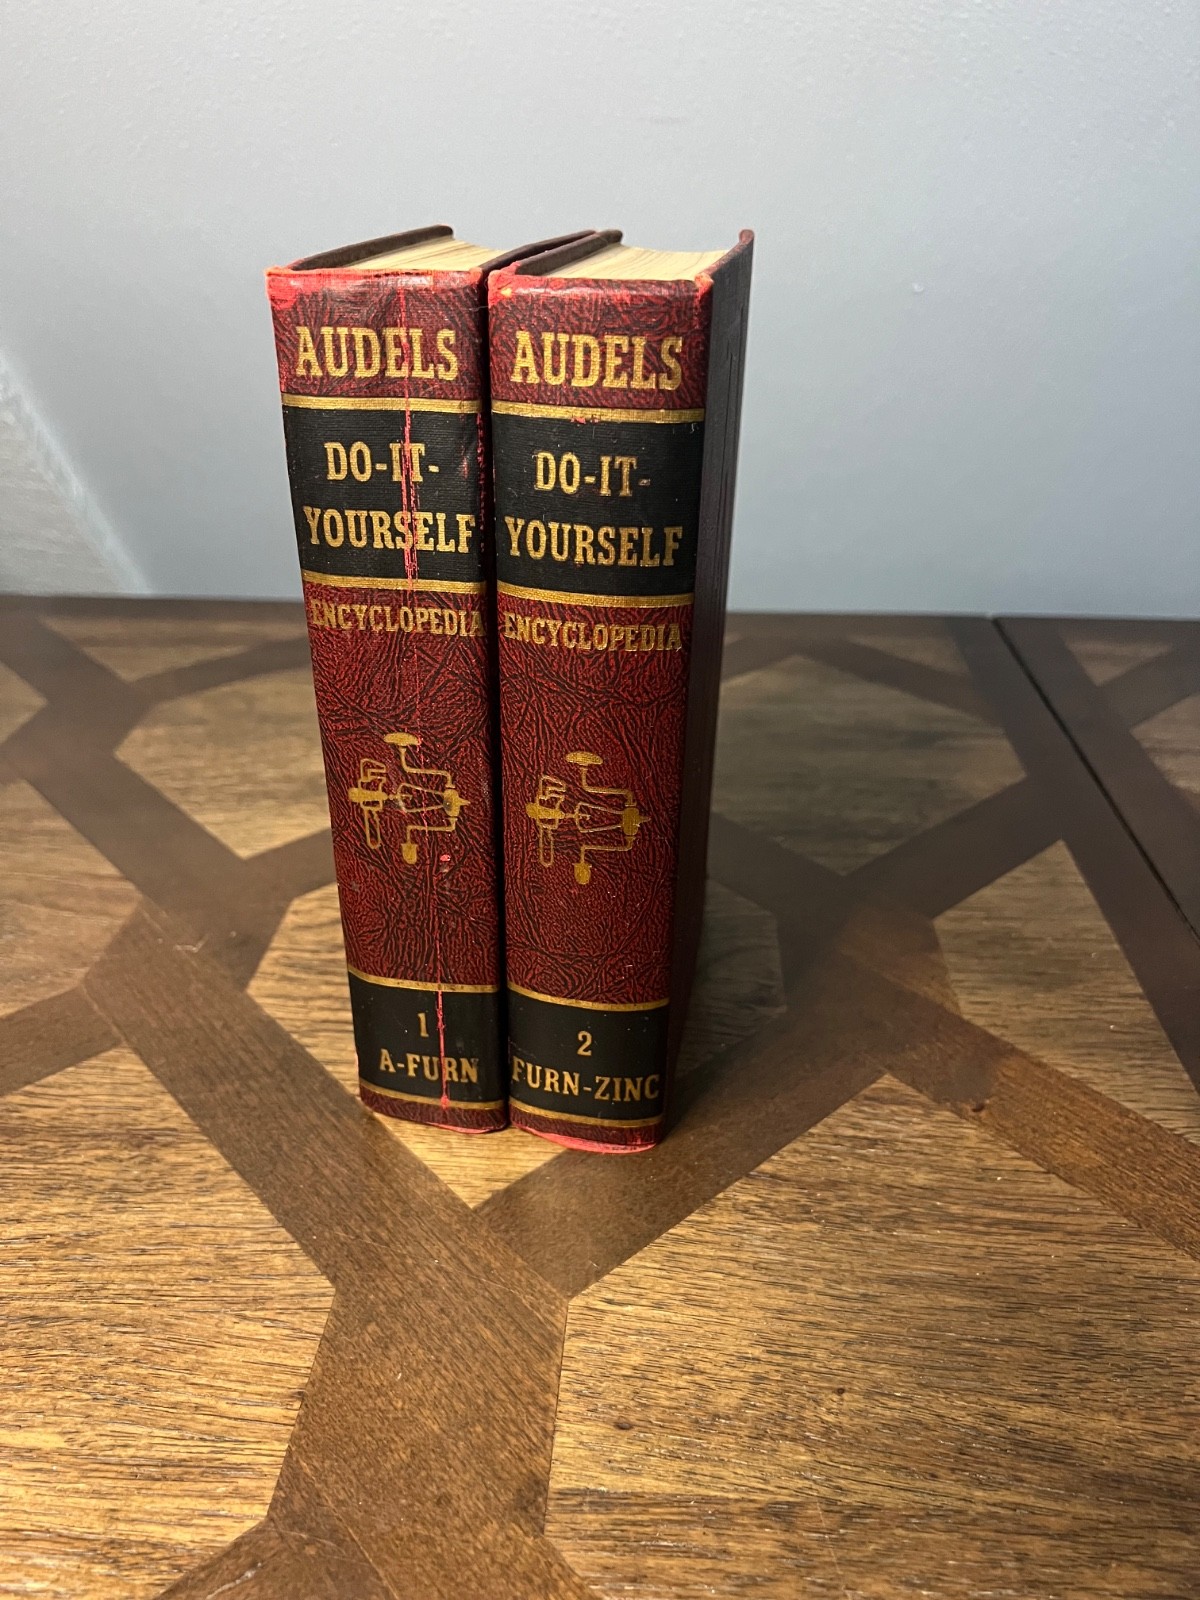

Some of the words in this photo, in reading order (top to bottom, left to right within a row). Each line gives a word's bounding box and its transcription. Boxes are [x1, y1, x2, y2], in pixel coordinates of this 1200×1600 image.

[296, 326, 458, 382] AUDELS
[511, 331, 683, 391] AUDELS
[324, 441, 439, 482] DO-IT-
[533, 451, 651, 497] DO-IT-
[304, 504, 476, 554] YOURSELF
[504, 516, 683, 568] YOURSELF
[310, 599, 486, 638] ENCYCLOPEDIA
[502, 612, 683, 652] ENCYCLOPEDIA
[417, 1012, 429, 1038] 1
[577, 1030, 593, 1057] 2
[379, 1048, 479, 1083] A-FURN
[512, 1057, 660, 1101] FURN-ZINC
